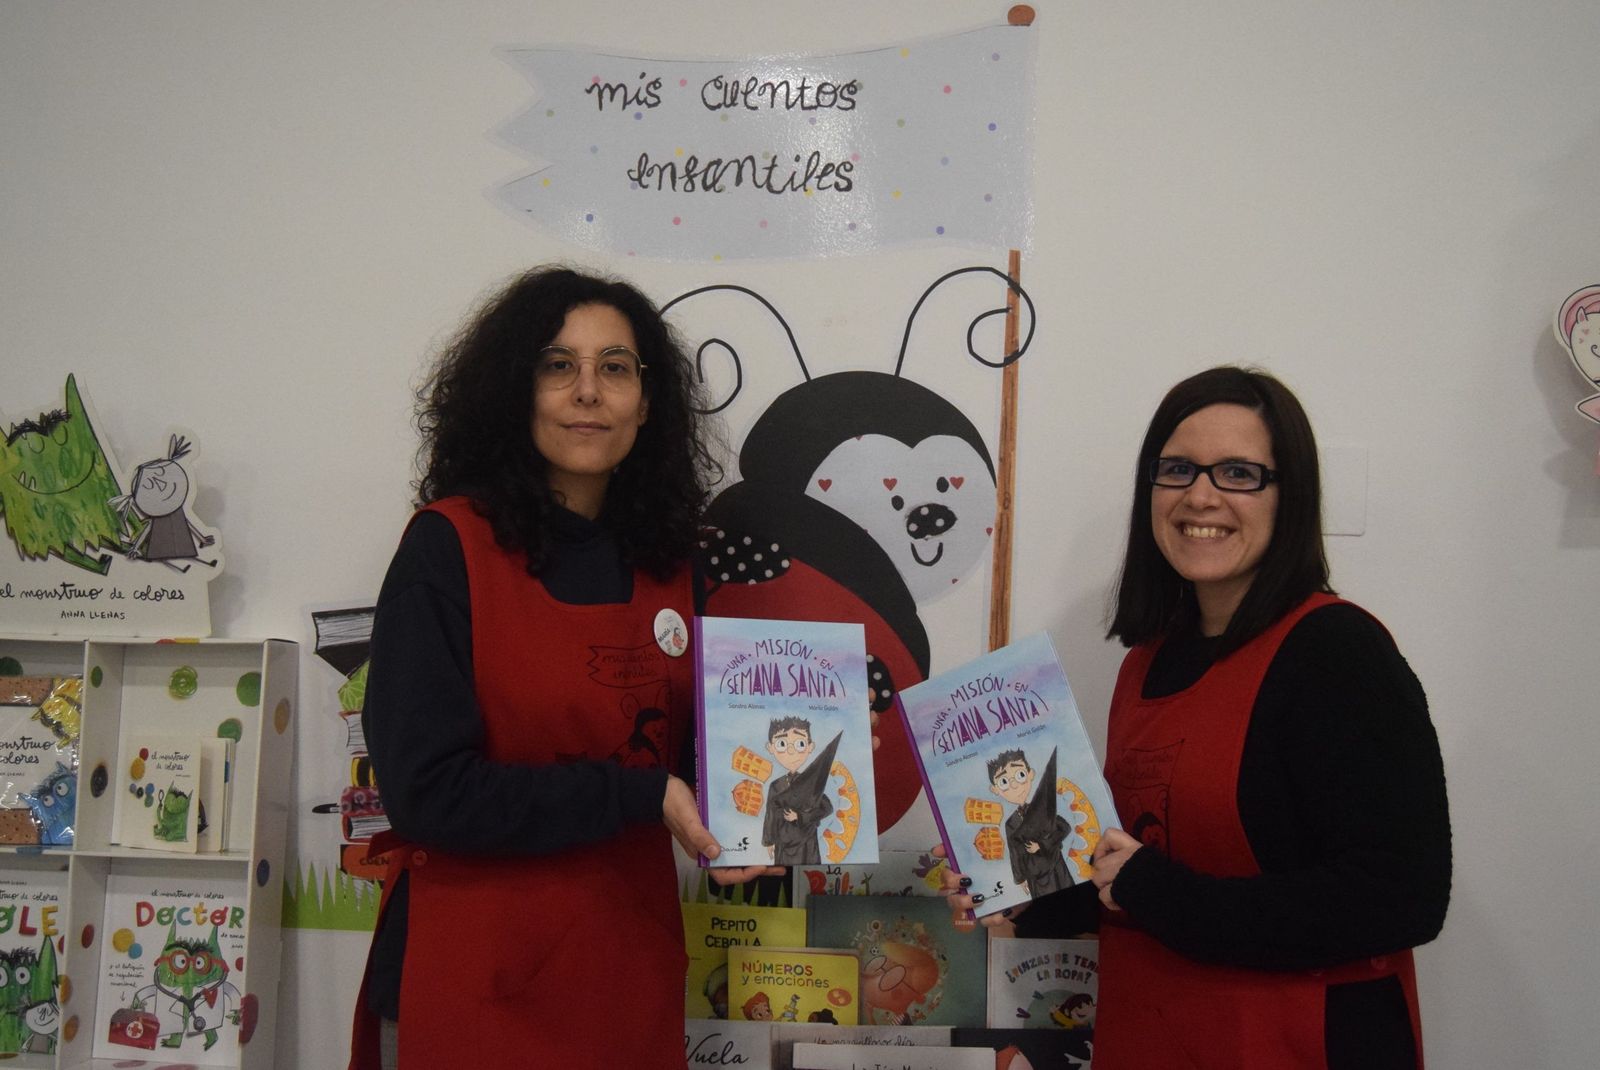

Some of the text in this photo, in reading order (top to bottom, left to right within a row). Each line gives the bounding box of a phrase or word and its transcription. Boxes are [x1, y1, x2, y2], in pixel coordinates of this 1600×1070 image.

[0, 582, 185, 601] el monstruo de colores
[61, 610, 125, 620] ANNA LLENAS
[727, 639, 835, 671] UNA MISIÓN EN
[727, 663, 836, 698] SEMANA SANTA
[932, 674, 1028, 730] UNA MISIÓN EN
[938, 696, 1040, 754] SEMANA SANTA
[711, 917, 757, 933] PEPITO
[742, 960, 813, 976] NÚMEROS
[742, 975, 830, 988] y emociones
[684, 1033, 749, 1065] Vuela
